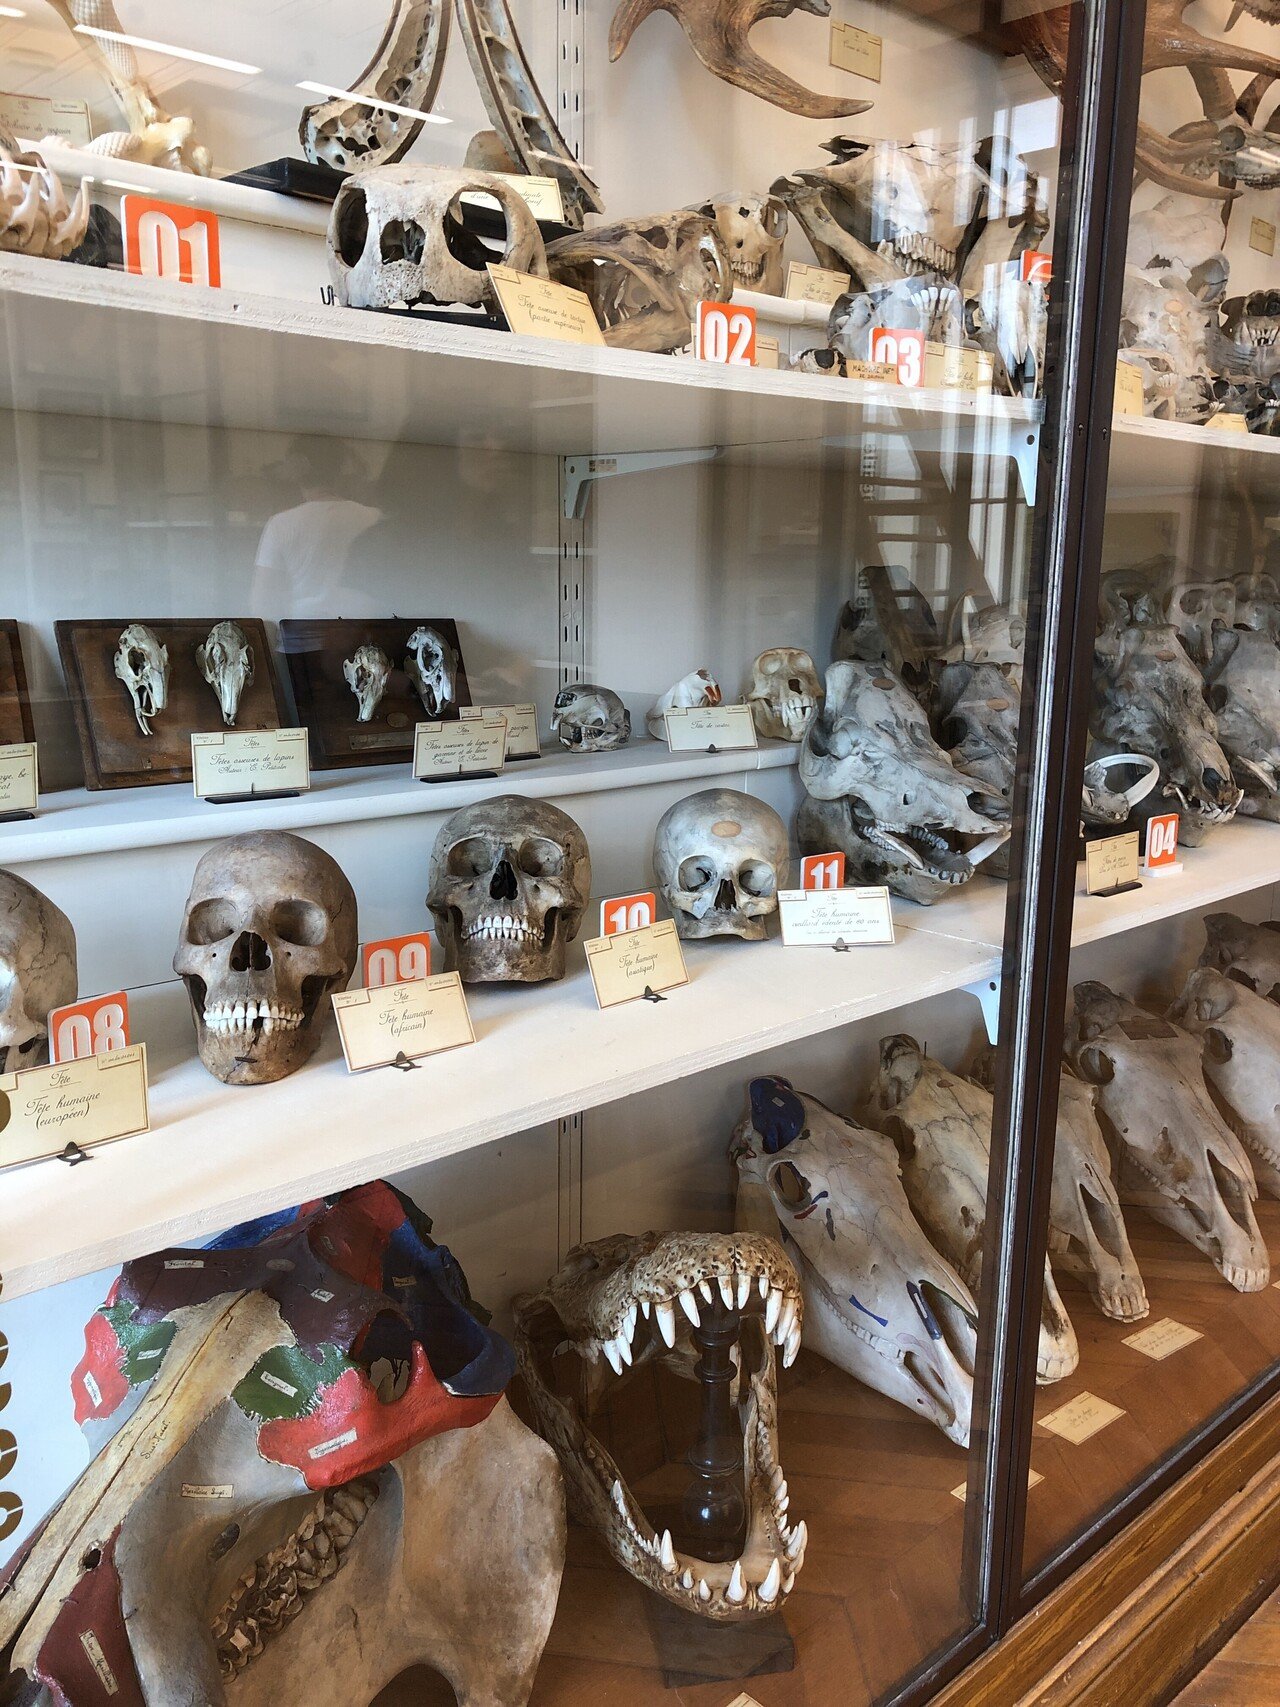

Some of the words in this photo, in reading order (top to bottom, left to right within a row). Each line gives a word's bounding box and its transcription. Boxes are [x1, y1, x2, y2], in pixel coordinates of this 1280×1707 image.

[138, 211, 210, 287] 01
[517, 293, 535, 309] Tête
[704, 310, 752, 366] 02
[874, 335, 921, 387] 03
[424, 739, 441, 751] Têtes
[466, 739, 473, 747] de
[210, 753, 231, 765] Têtes
[263, 754, 271, 762] de
[273, 753, 294, 764] lapins
[1150, 820, 1176, 859] 04
[810, 859, 839, 890] 11
[609, 901, 650, 933] 10
[831, 908, 860, 917] humaine
[368, 942, 427, 987] 09
[618, 954, 633, 969] Tête
[635, 952, 659, 964] humaine
[393, 987, 409, 1002] Tête
[379, 1009, 398, 1025] Tête
[401, 1008, 434, 1020] humaine
[390, 1017, 426, 1037] (africain)
[58, 1003, 126, 1063] 08
[50, 1068, 71, 1087] Tête
[24, 1095, 50, 1117] Tête
[56, 1091, 102, 1109] humaine
[35, 1101, 90, 1130] (européen)
